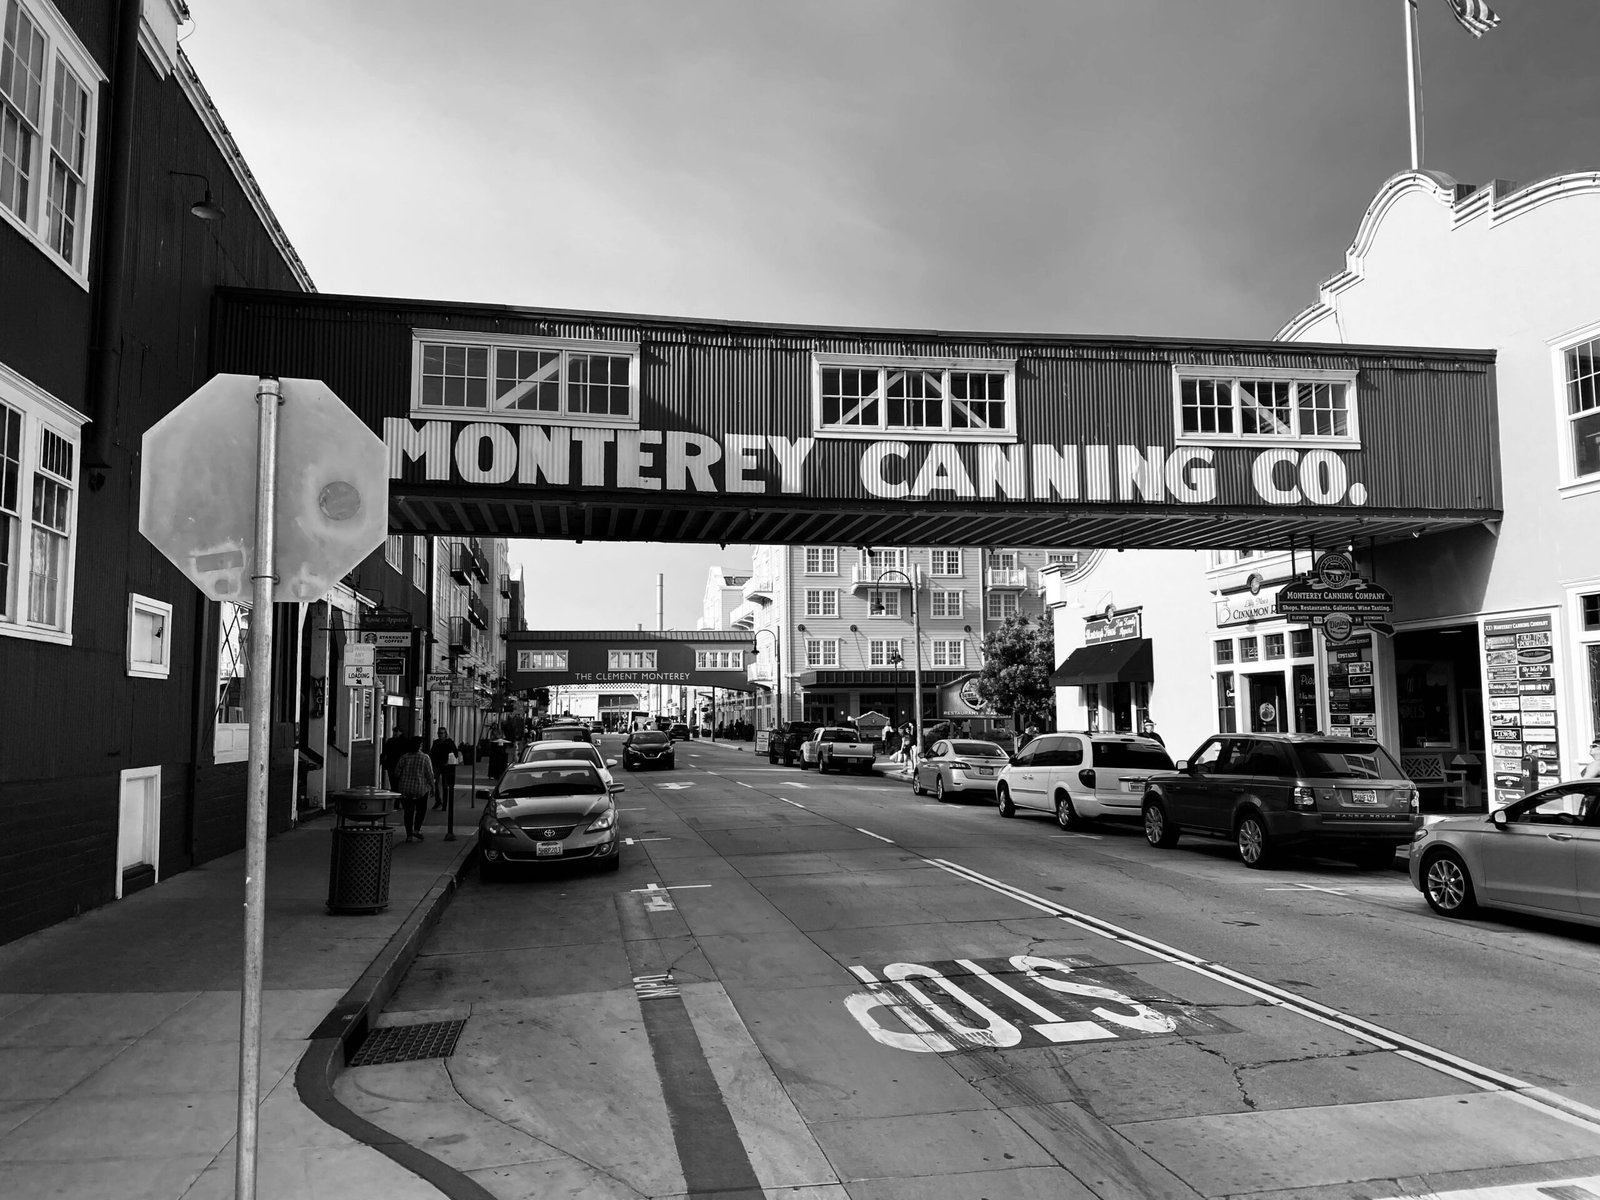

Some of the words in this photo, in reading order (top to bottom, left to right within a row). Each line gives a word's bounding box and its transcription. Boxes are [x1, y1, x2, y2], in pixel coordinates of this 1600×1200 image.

[383, 416, 815, 494] MONTEREY
[859, 441, 1217, 503] CANNING
[1252, 448, 1368, 506] CO.
[1286, 591, 1322, 600] MONTEREY
[1323, 591, 1354, 600] CANNING
[1355, 591, 1386, 600] COMPANY
[1233, 606, 1270, 619] CINNAMON
[575, 672, 593, 681] THE
[596, 672, 638, 681] CLEMENT
[641, 672, 691, 681] MONTEREY
[844, 955, 1176, 1053] STOP
